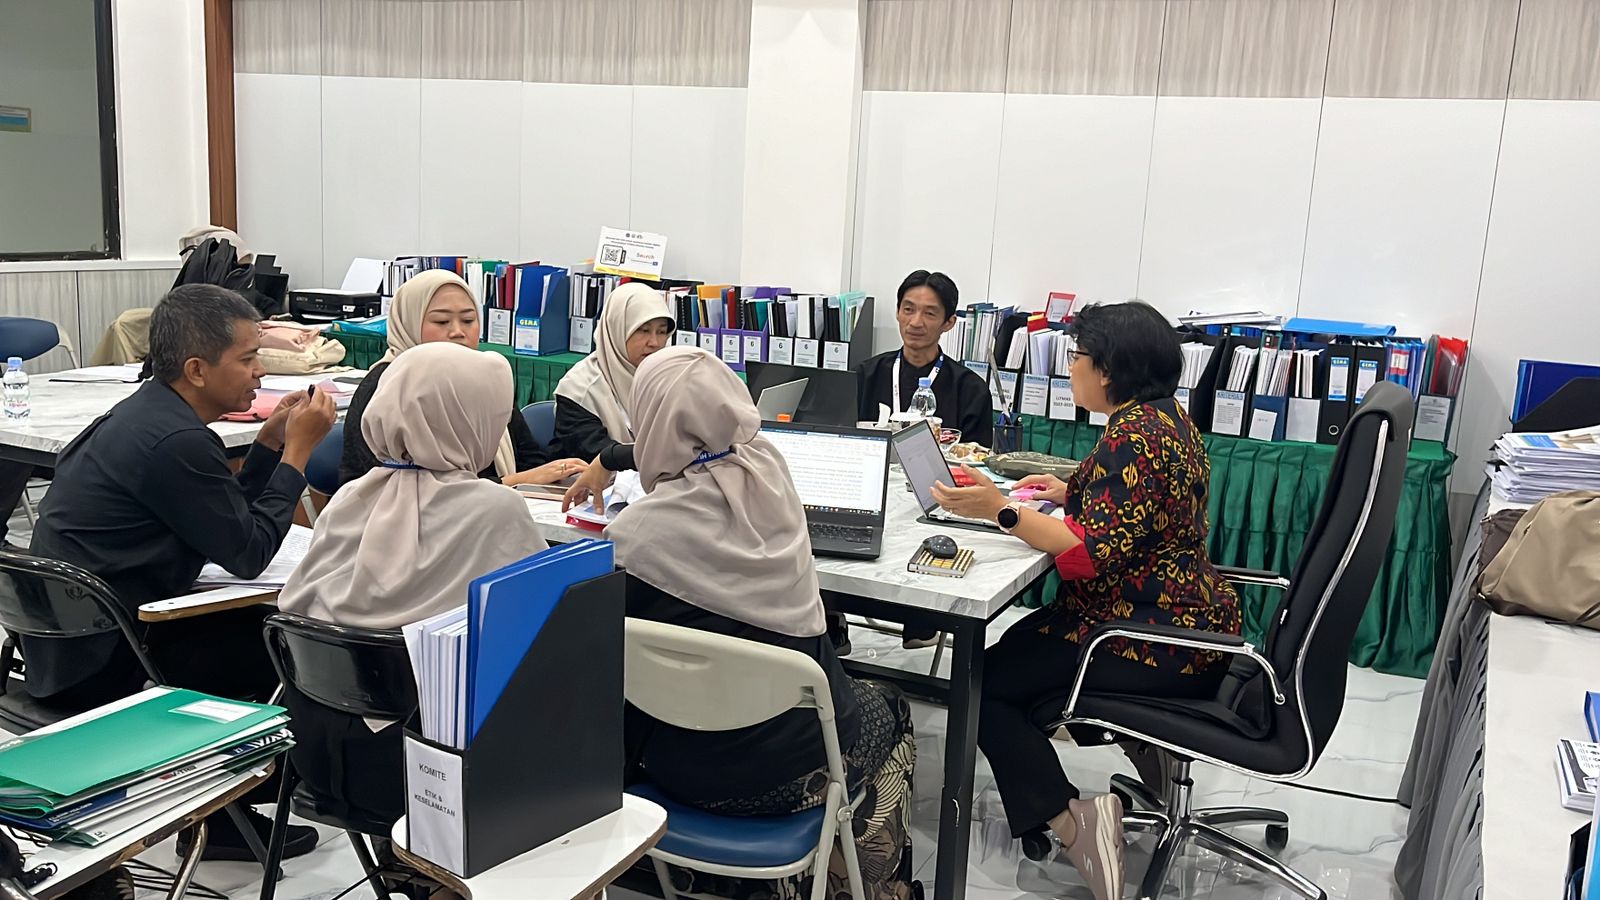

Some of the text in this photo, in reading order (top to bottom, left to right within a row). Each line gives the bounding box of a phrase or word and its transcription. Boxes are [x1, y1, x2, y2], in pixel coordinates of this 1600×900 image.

[418, 762, 447, 781] KOMITE
[424, 789, 437, 800] ETIK
[414, 793, 456, 817] KESELAMATAN
